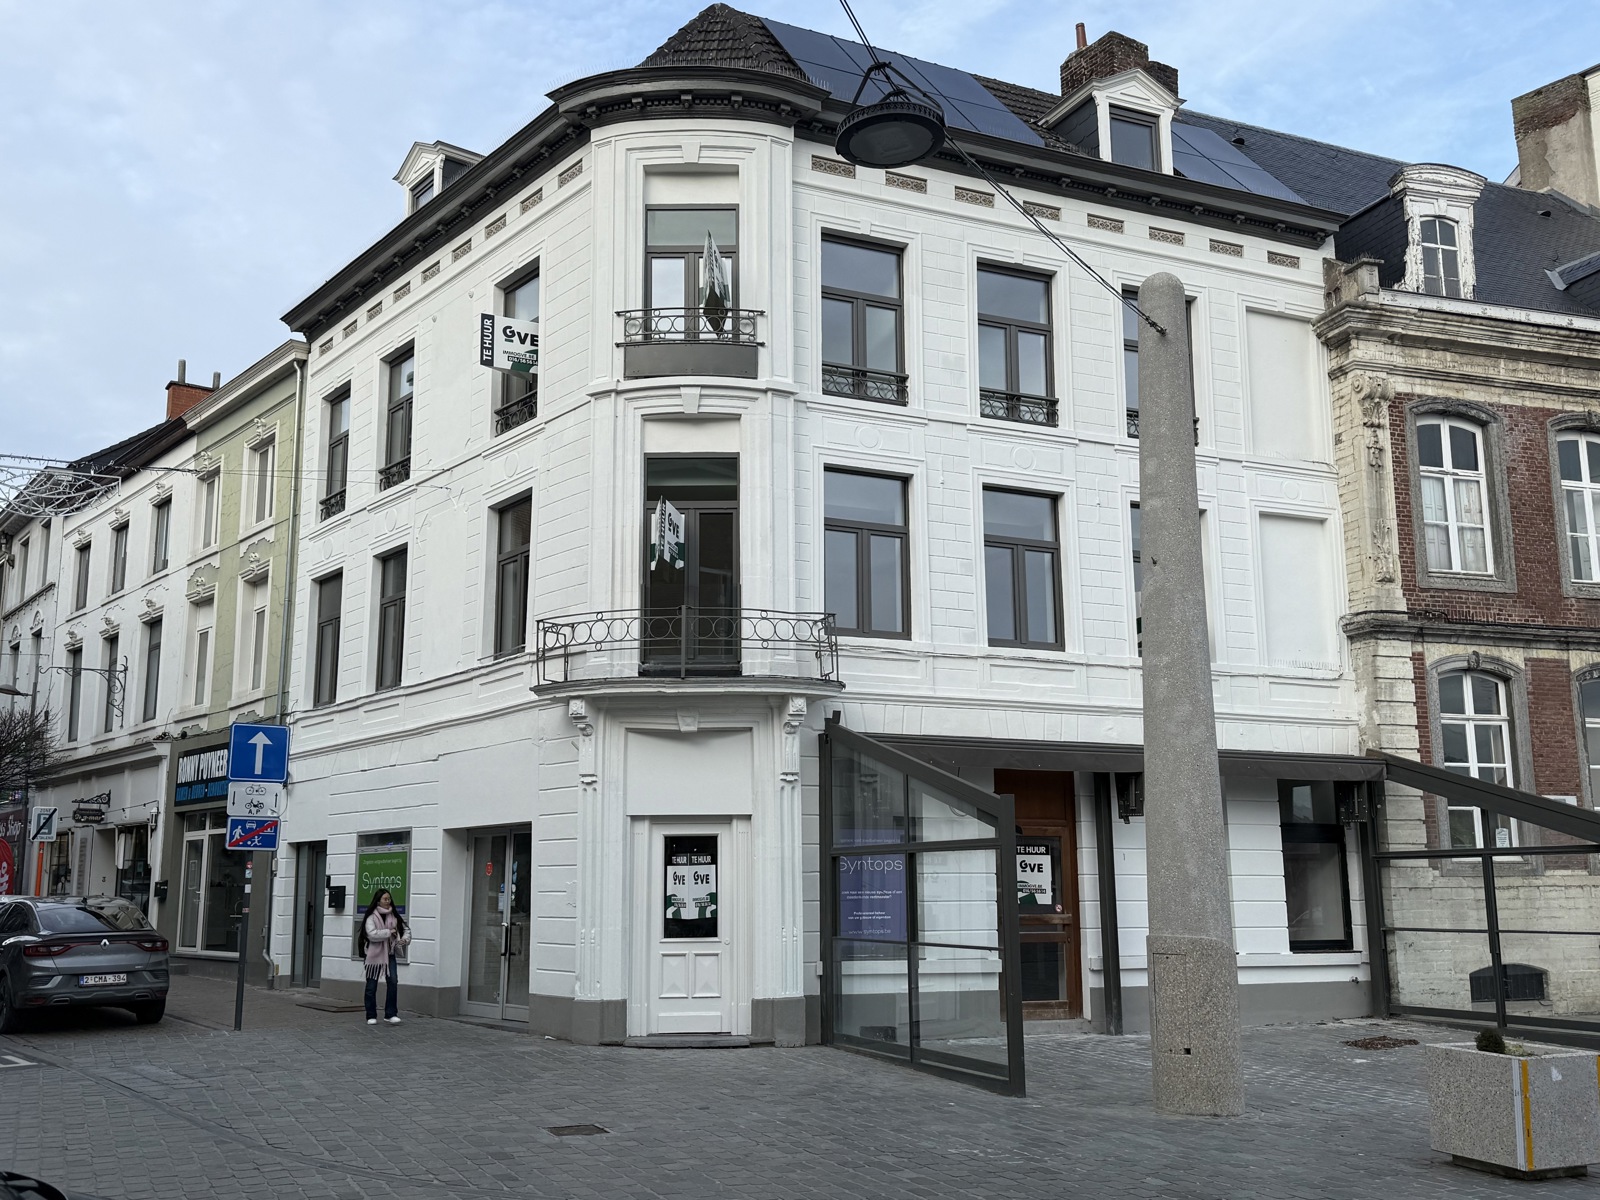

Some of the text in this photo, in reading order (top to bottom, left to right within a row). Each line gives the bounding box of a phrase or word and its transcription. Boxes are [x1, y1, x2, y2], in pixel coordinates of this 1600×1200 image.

[483, 319, 493, 361] TE HUUR
[502, 325, 539, 347] GVE
[668, 512, 680, 540] GVE
[177, 754, 200, 784] RONNY
[1026, 846, 1046, 854] HUUR
[671, 856, 687, 864] TE HUUR
[691, 855, 711, 864] TE HUUR
[840, 856, 903, 875] Syntops
[1020, 860, 1043, 873] GVE
[362, 871, 402, 894] Syntops
[673, 871, 686, 885] GVE
[693, 871, 710, 885] GVE
